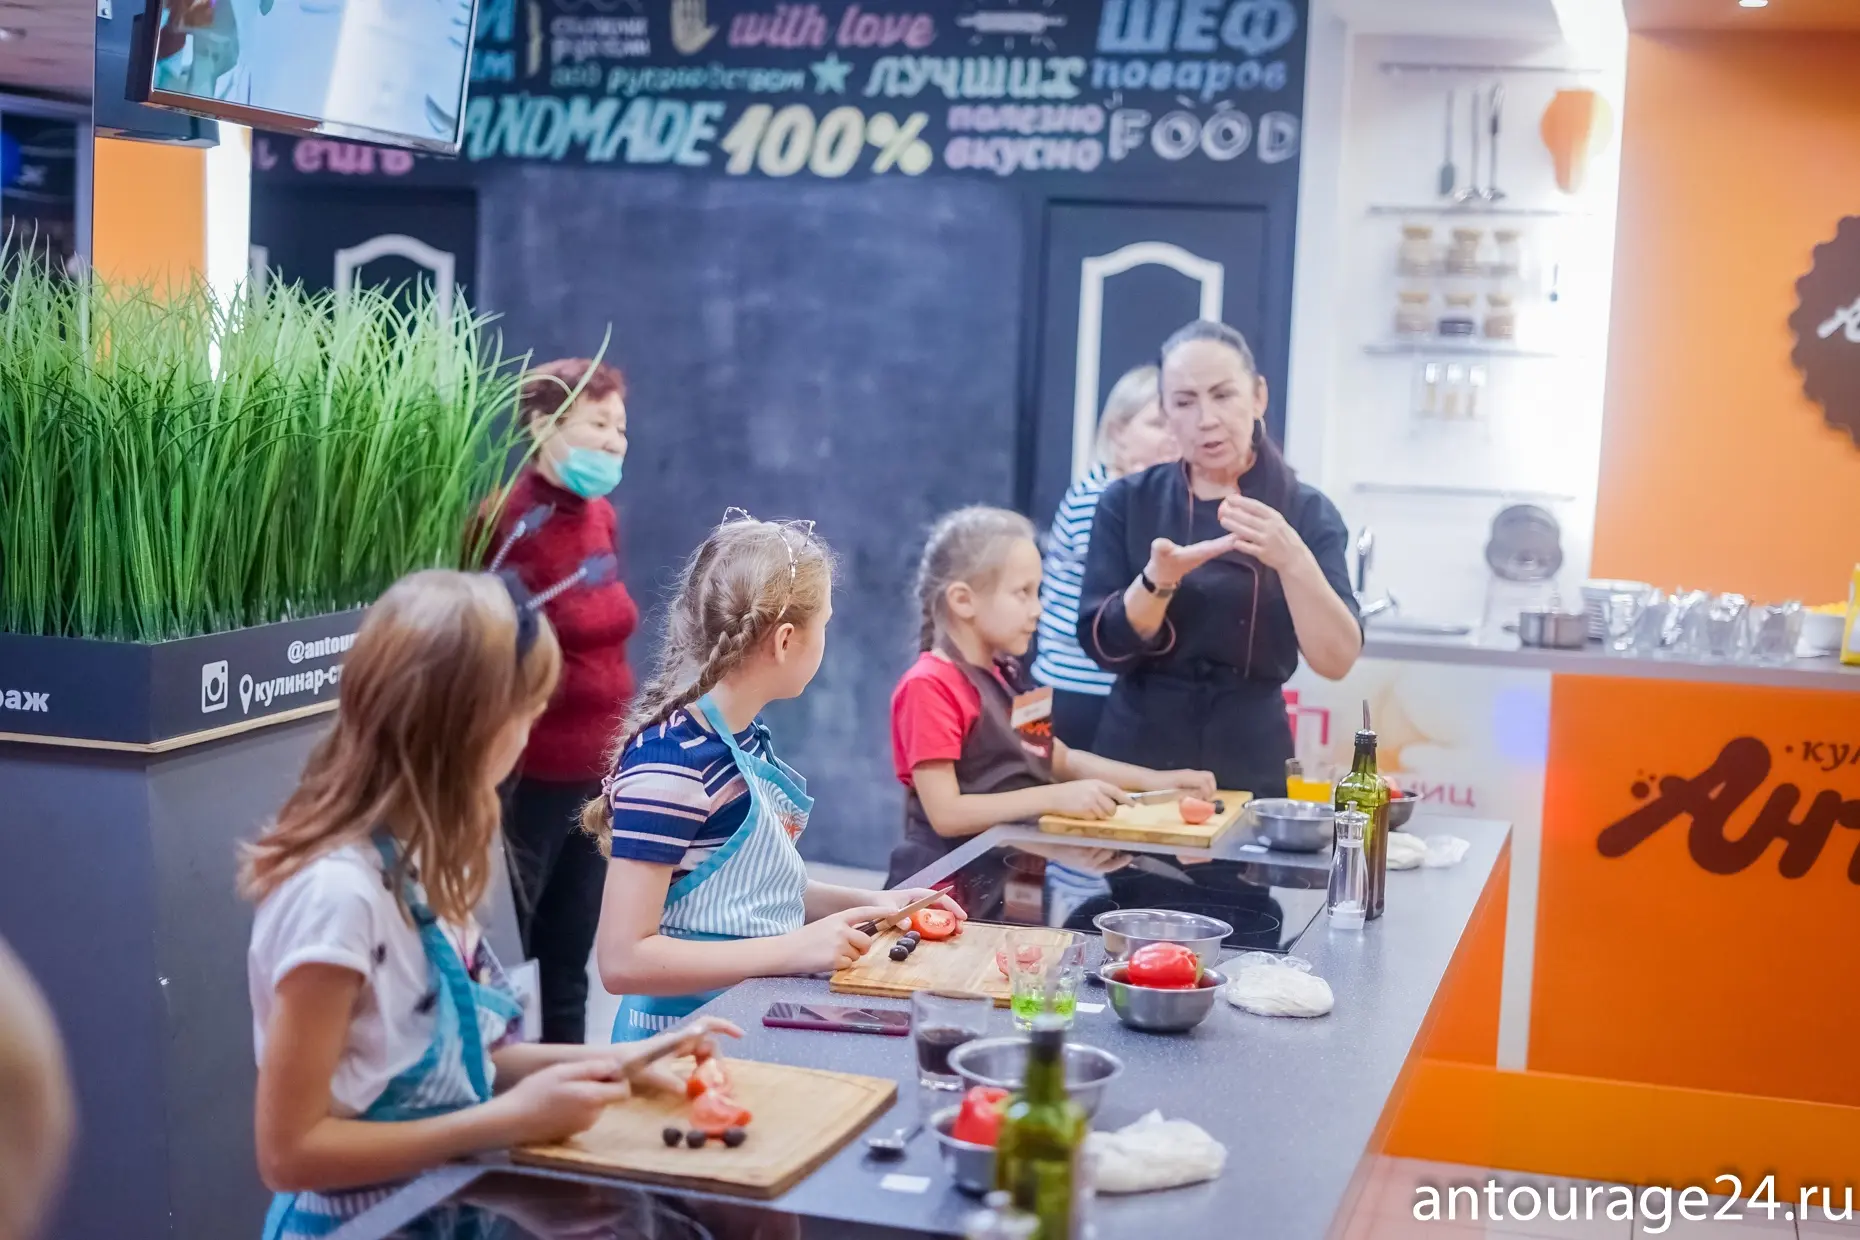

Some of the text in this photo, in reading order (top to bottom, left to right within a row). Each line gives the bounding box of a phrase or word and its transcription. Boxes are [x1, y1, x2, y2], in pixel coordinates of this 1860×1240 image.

[728, 6, 937, 48] with love
[1096, 0, 1298, 55] ШЕФ
[464, 96, 727, 166] ANDMADE
[719, 103, 934, 178] 100%
[1107, 108, 1299, 164] FOOD
[287, 632, 360, 665] @antour
[0, 689, 50, 712] аж
[255, 664, 345, 707] кулинар-ст
